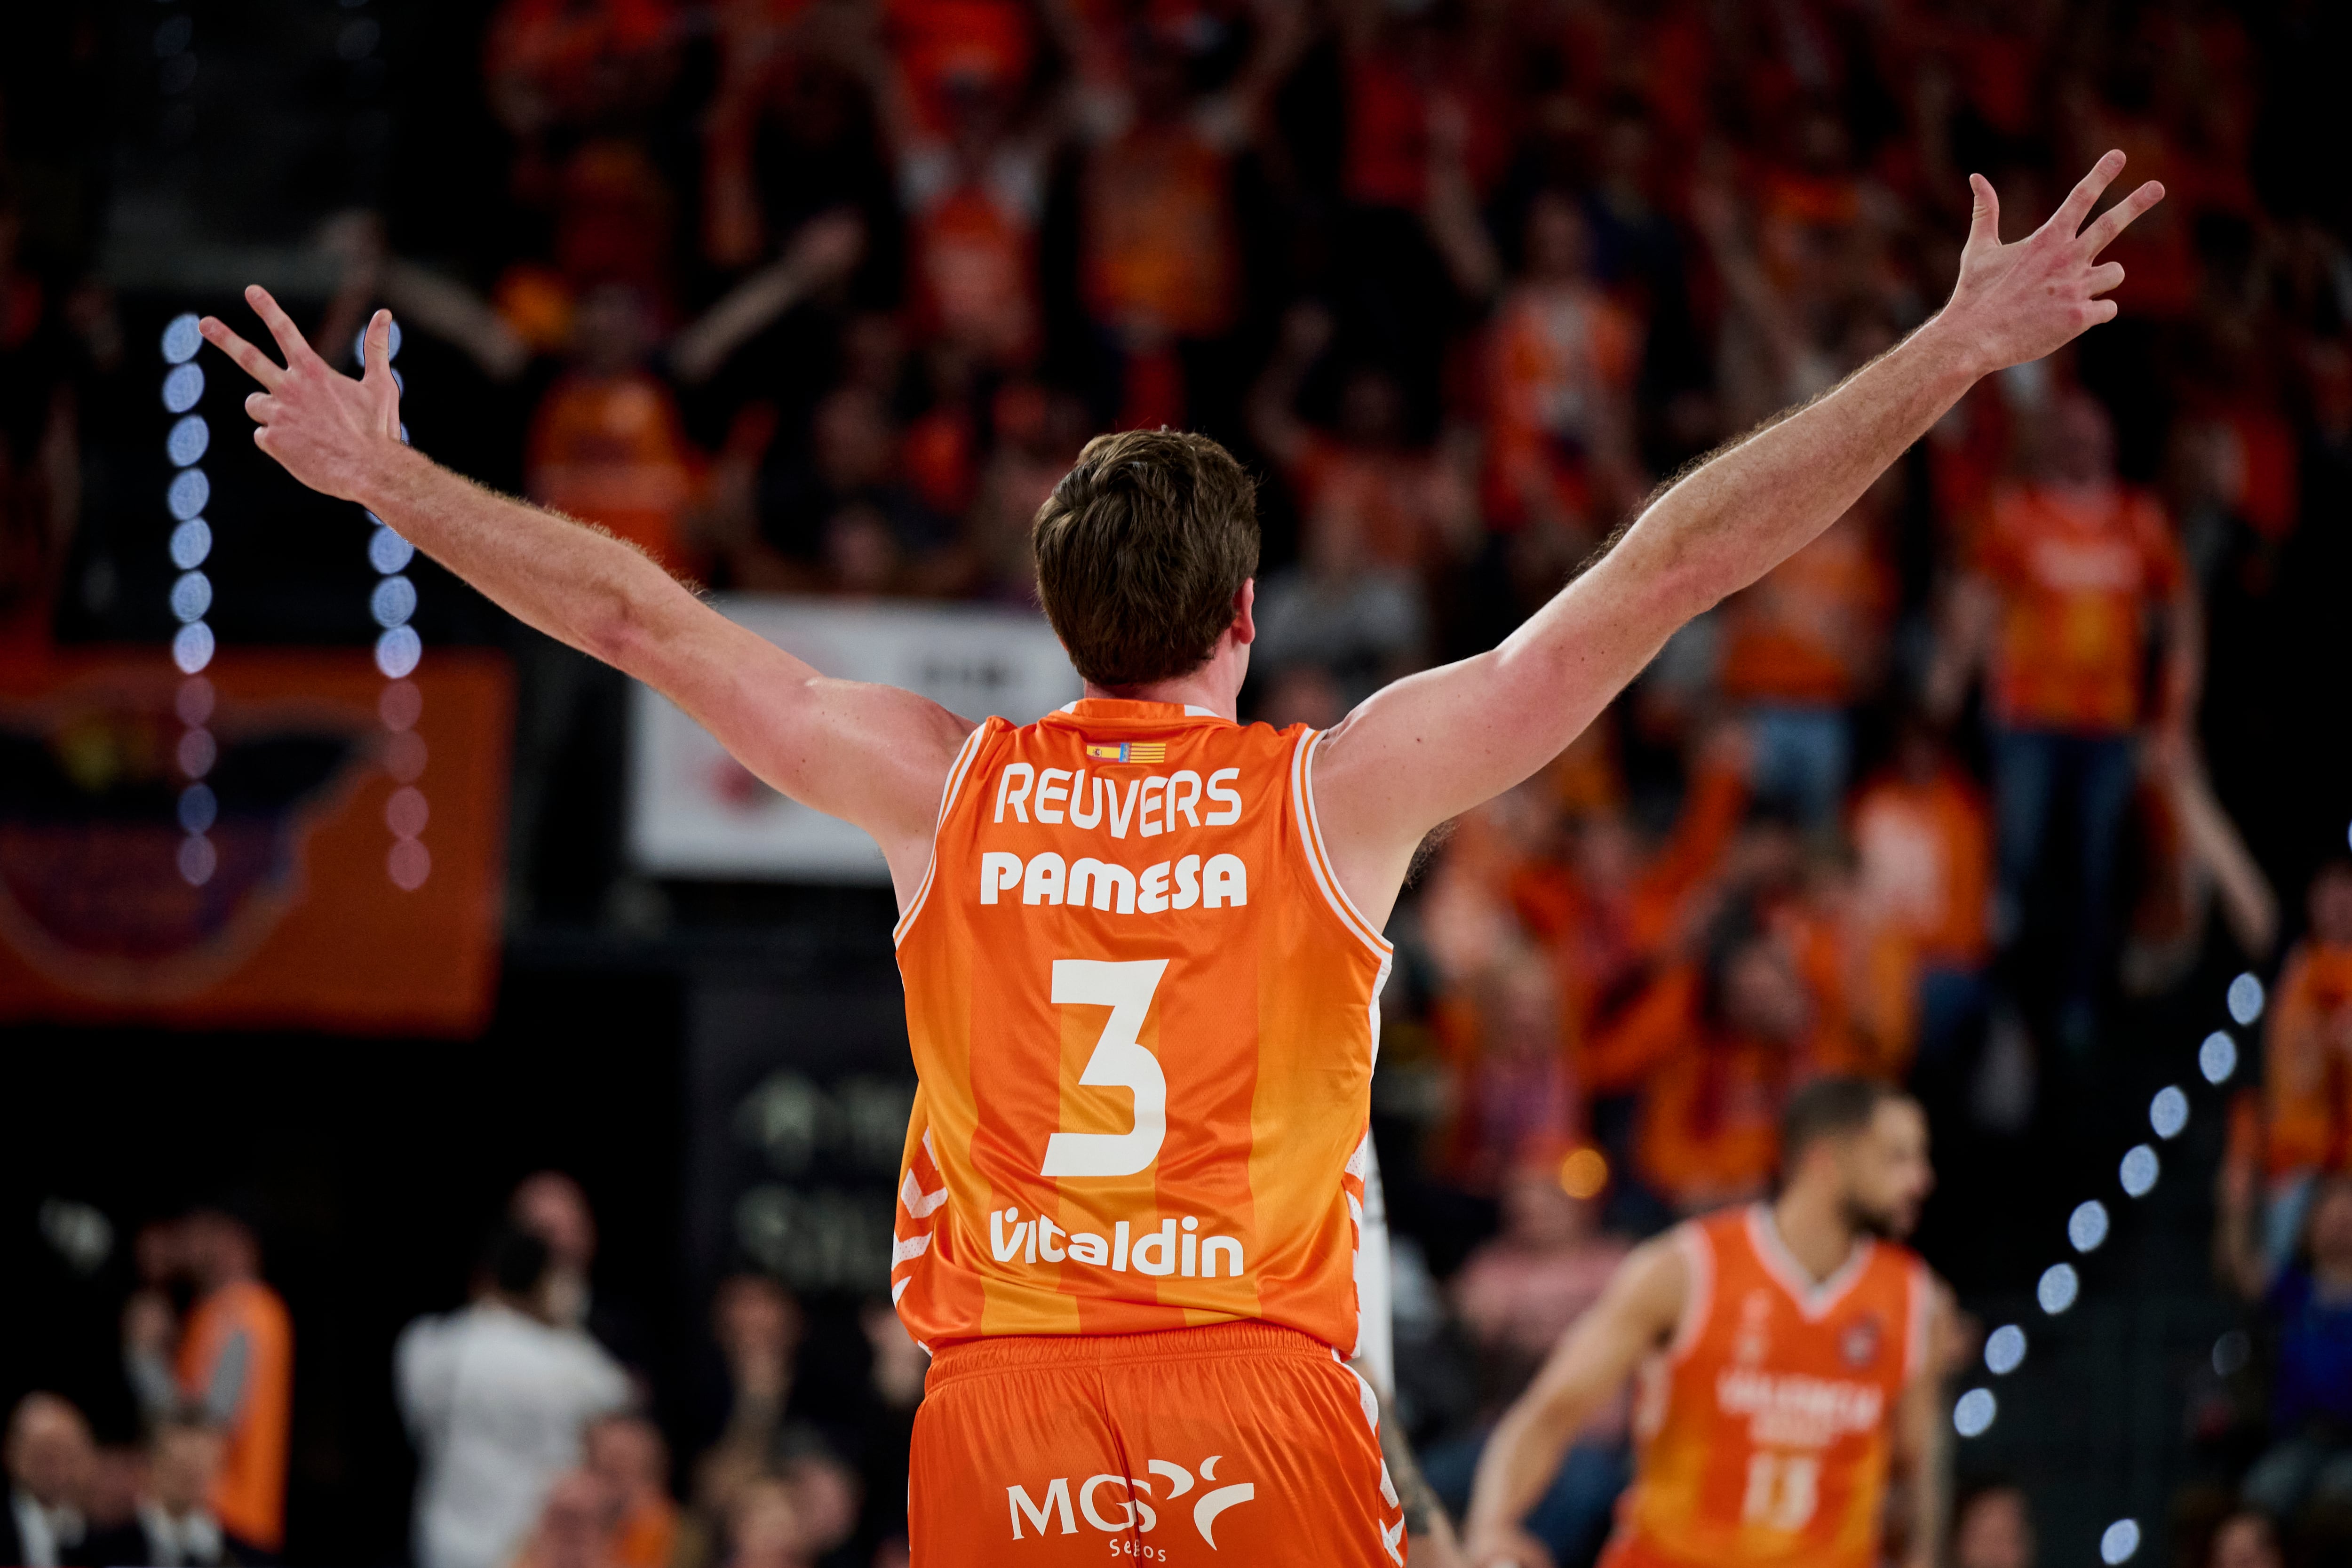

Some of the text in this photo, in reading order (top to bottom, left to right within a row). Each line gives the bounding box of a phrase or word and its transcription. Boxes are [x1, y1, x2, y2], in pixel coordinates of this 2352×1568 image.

[994, 763, 1241, 839] REUVERS
[981, 852, 1247, 914] PAMESA
[1041, 958, 1169, 1176] 3
[1006, 1474, 1157, 1540] MGS
